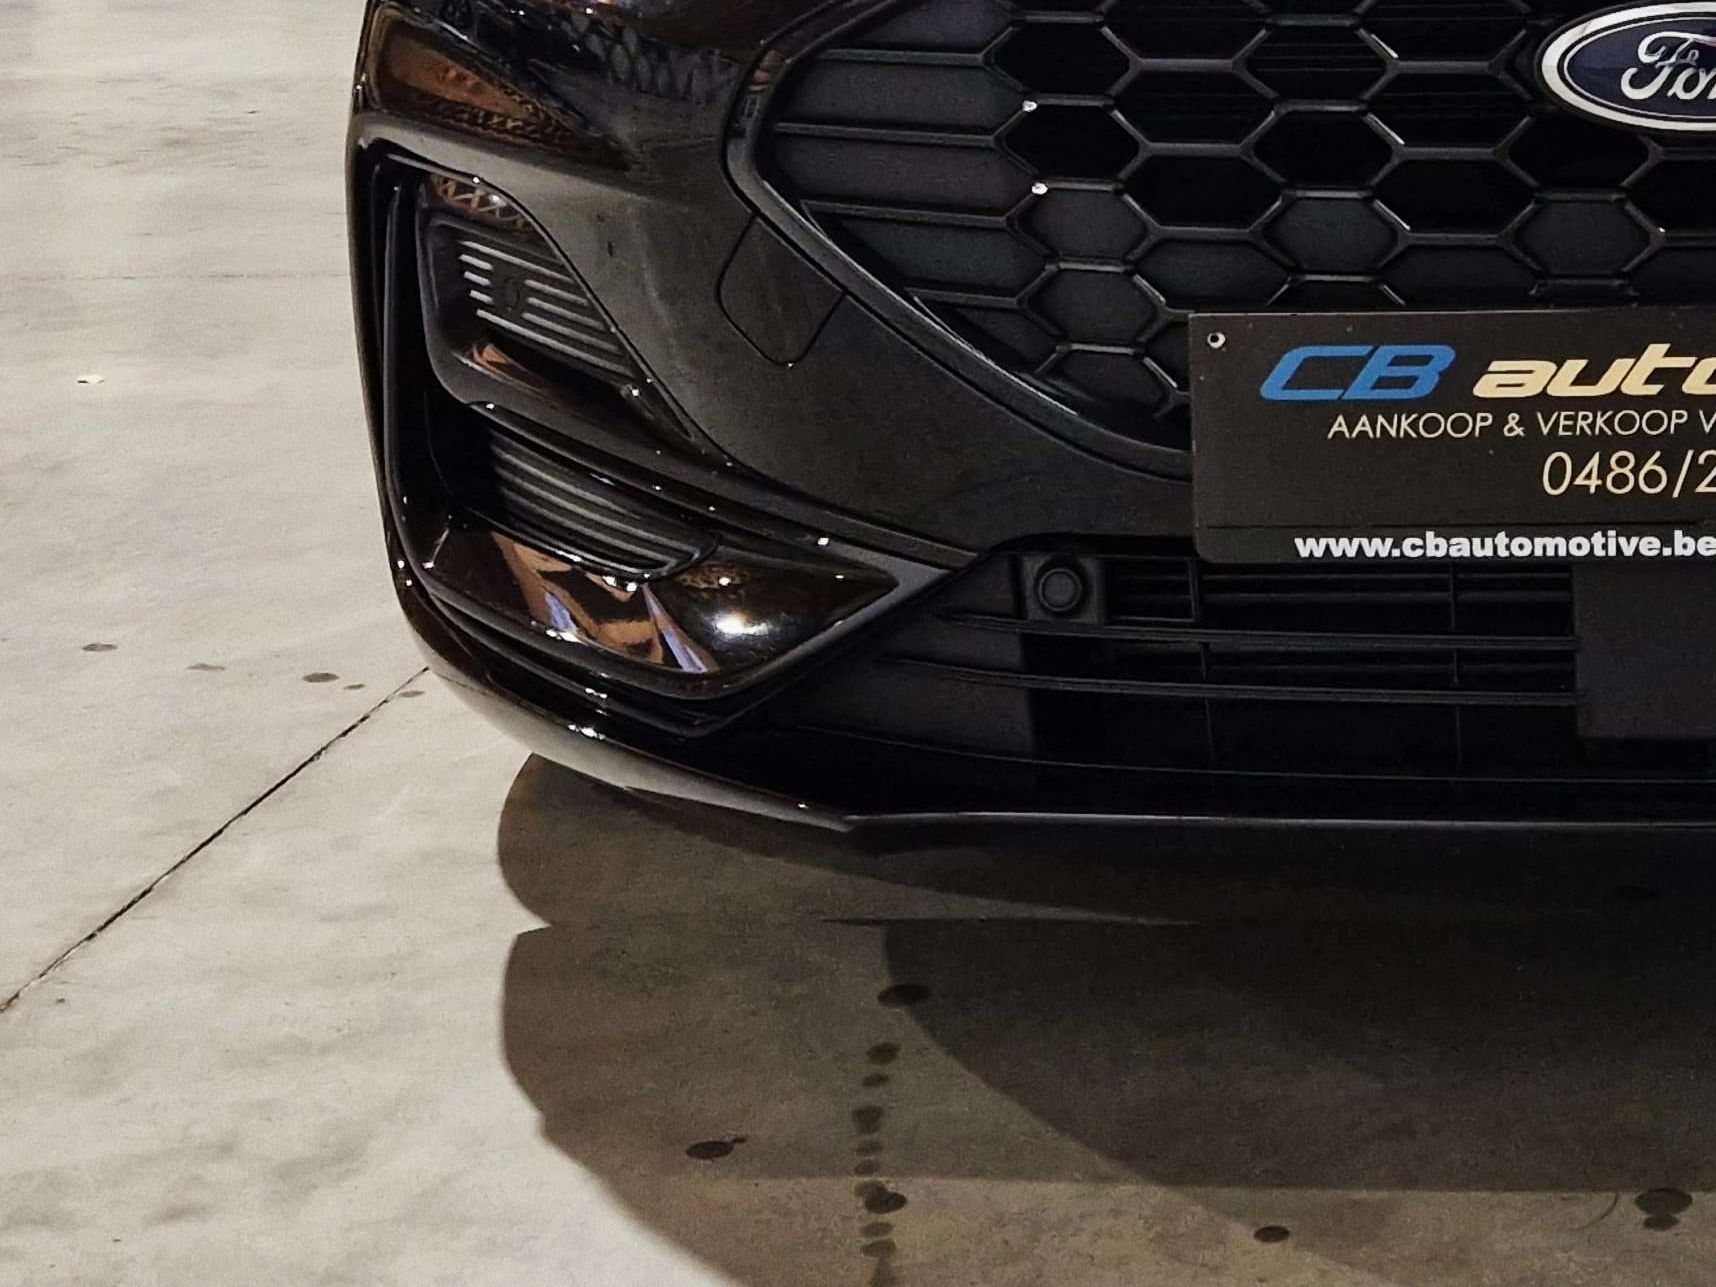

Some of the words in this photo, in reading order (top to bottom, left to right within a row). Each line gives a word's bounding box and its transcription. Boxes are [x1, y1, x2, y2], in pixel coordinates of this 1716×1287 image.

[1259, 343, 1457, 401] CB
[1327, 411, 1493, 440] AANKOOP
[1502, 411, 1526, 437] &
[1535, 409, 1689, 436] VERKOOP
